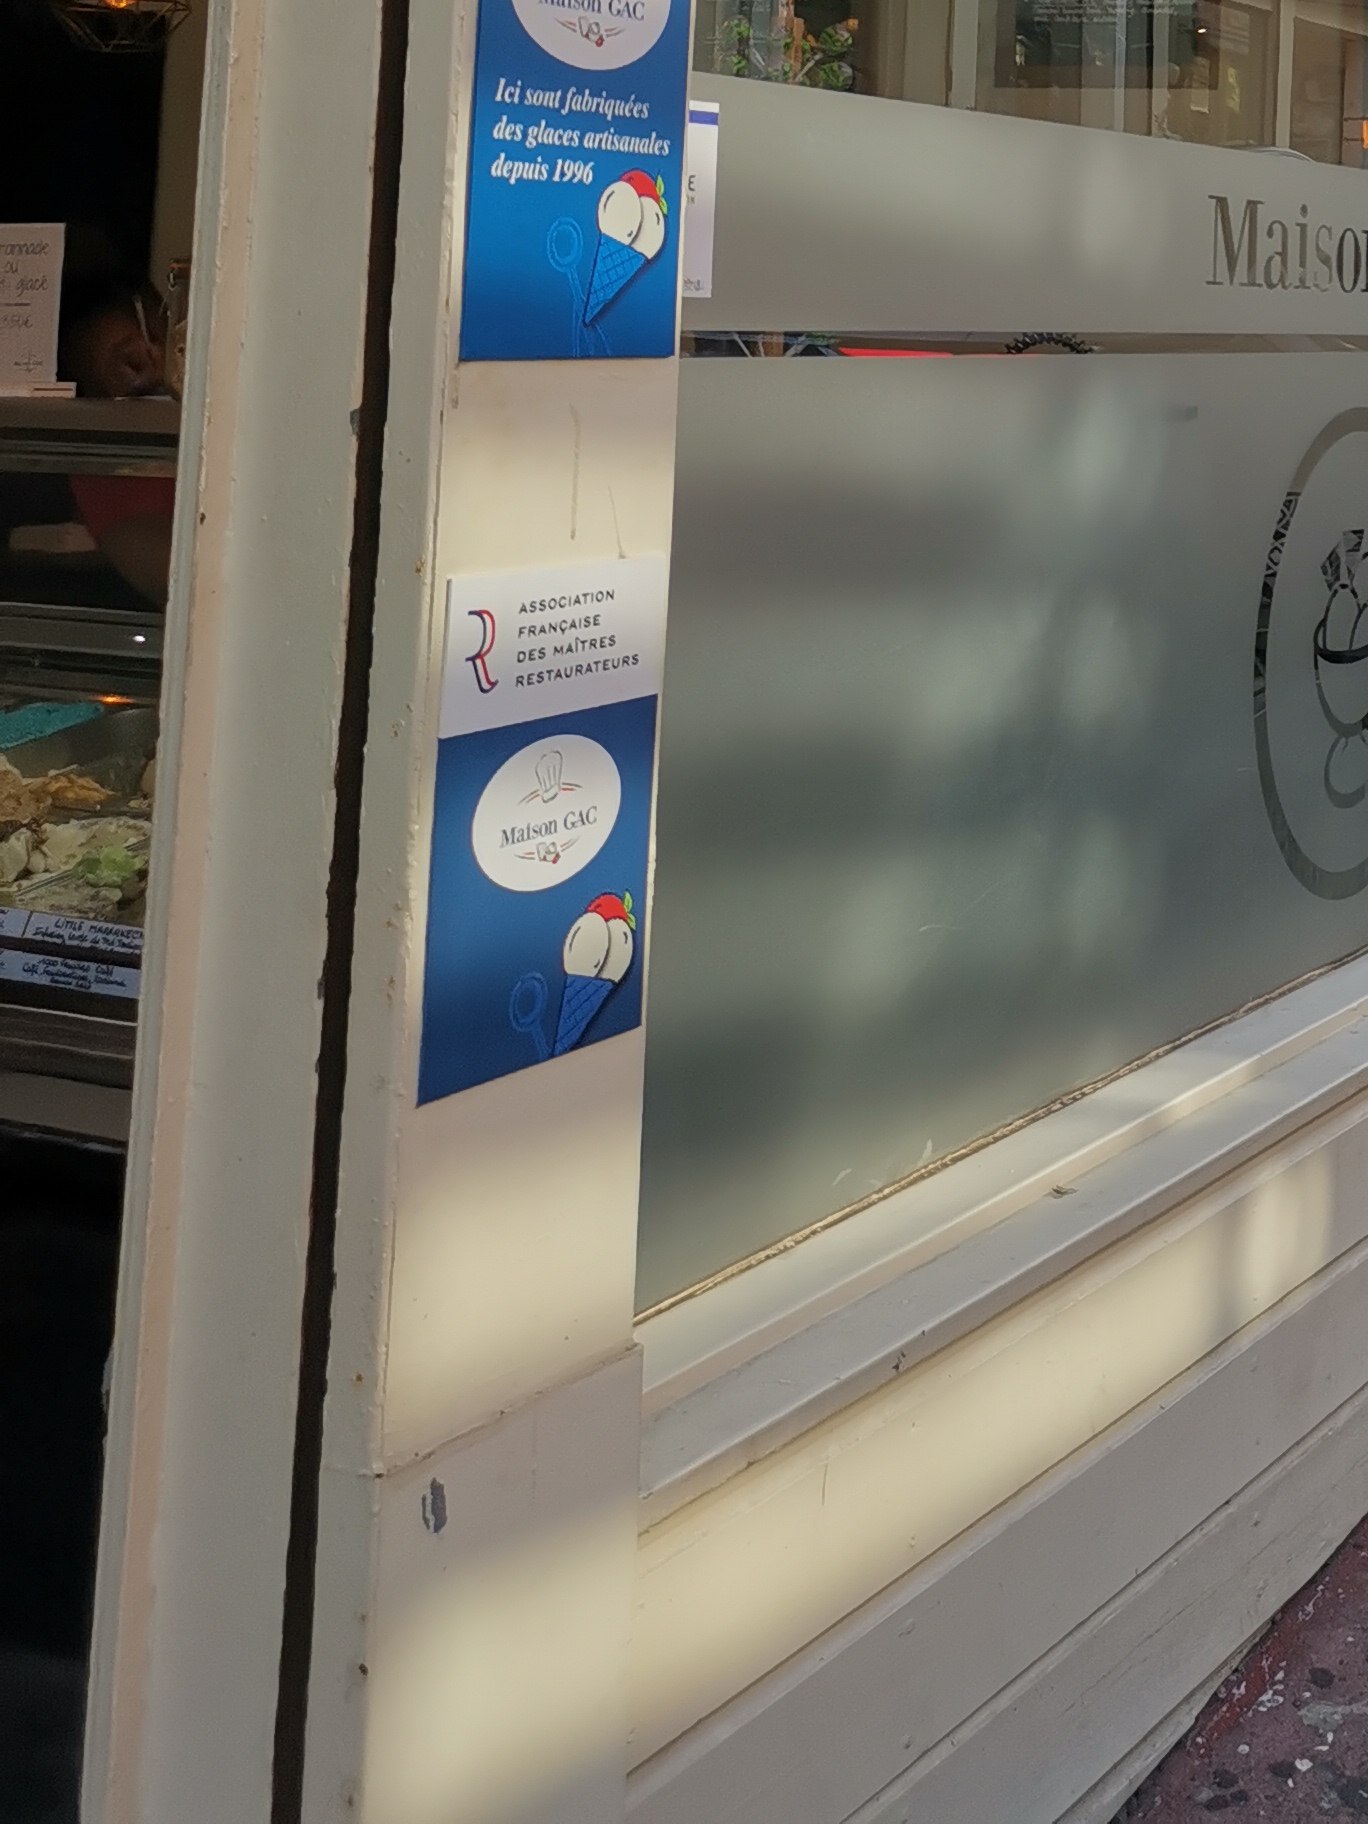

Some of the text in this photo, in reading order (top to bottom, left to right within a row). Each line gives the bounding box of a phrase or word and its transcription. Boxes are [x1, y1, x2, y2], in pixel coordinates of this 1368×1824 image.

[495, 77, 650, 122] Ici sont fabriquées
[492, 115, 671, 157] des glaces artisanales
[491, 152, 595, 186] depuis 1996
[518, 588, 615, 615] ASSOCIATION
[517, 614, 601, 638] FRANÇAISE
[516, 636, 617, 663] DES MAÎTRES
[514, 653, 640, 688] RESTAURATEURS
[499, 805, 597, 848] Maison GAC
